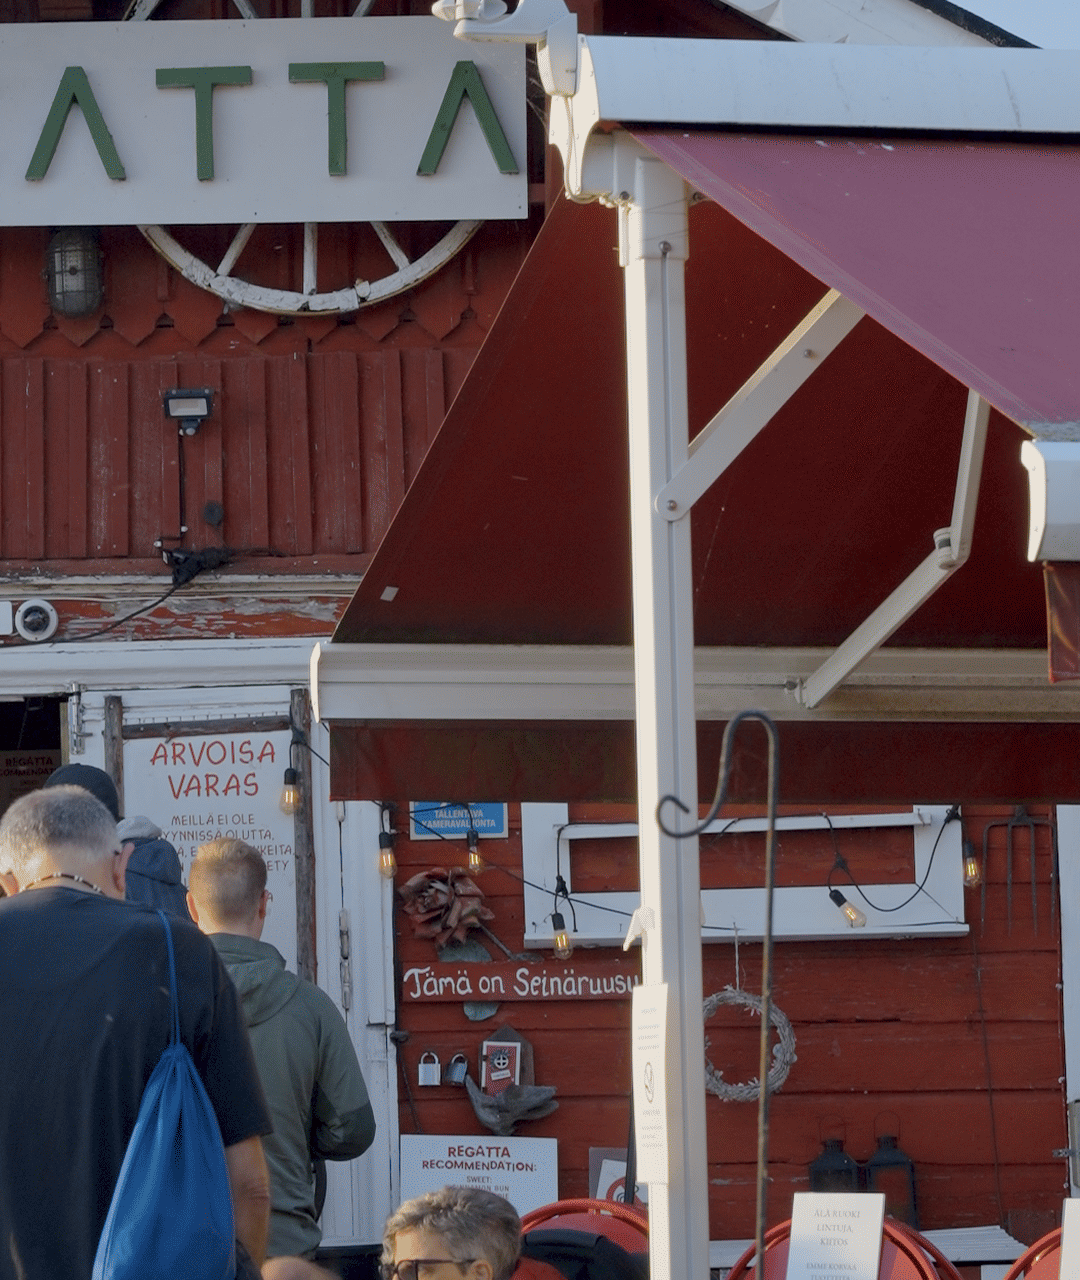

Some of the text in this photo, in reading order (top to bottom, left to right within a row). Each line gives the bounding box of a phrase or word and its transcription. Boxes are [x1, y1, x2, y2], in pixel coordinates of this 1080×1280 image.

[149, 739, 276, 768] ARVOISA
[168, 772, 259, 800] VARAS
[171, 812, 255, 826] MEILLÄ EI OLE
[162, 827, 222, 841] YYNNISSÄ
[403, 966, 639, 999] Tämä on Seinäruusu
[448, 1145, 511, 1158] REGATTA
[422, 1160, 537, 1172] RECOMMENDATION:
[466, 1175, 492, 1184] SWEET:
